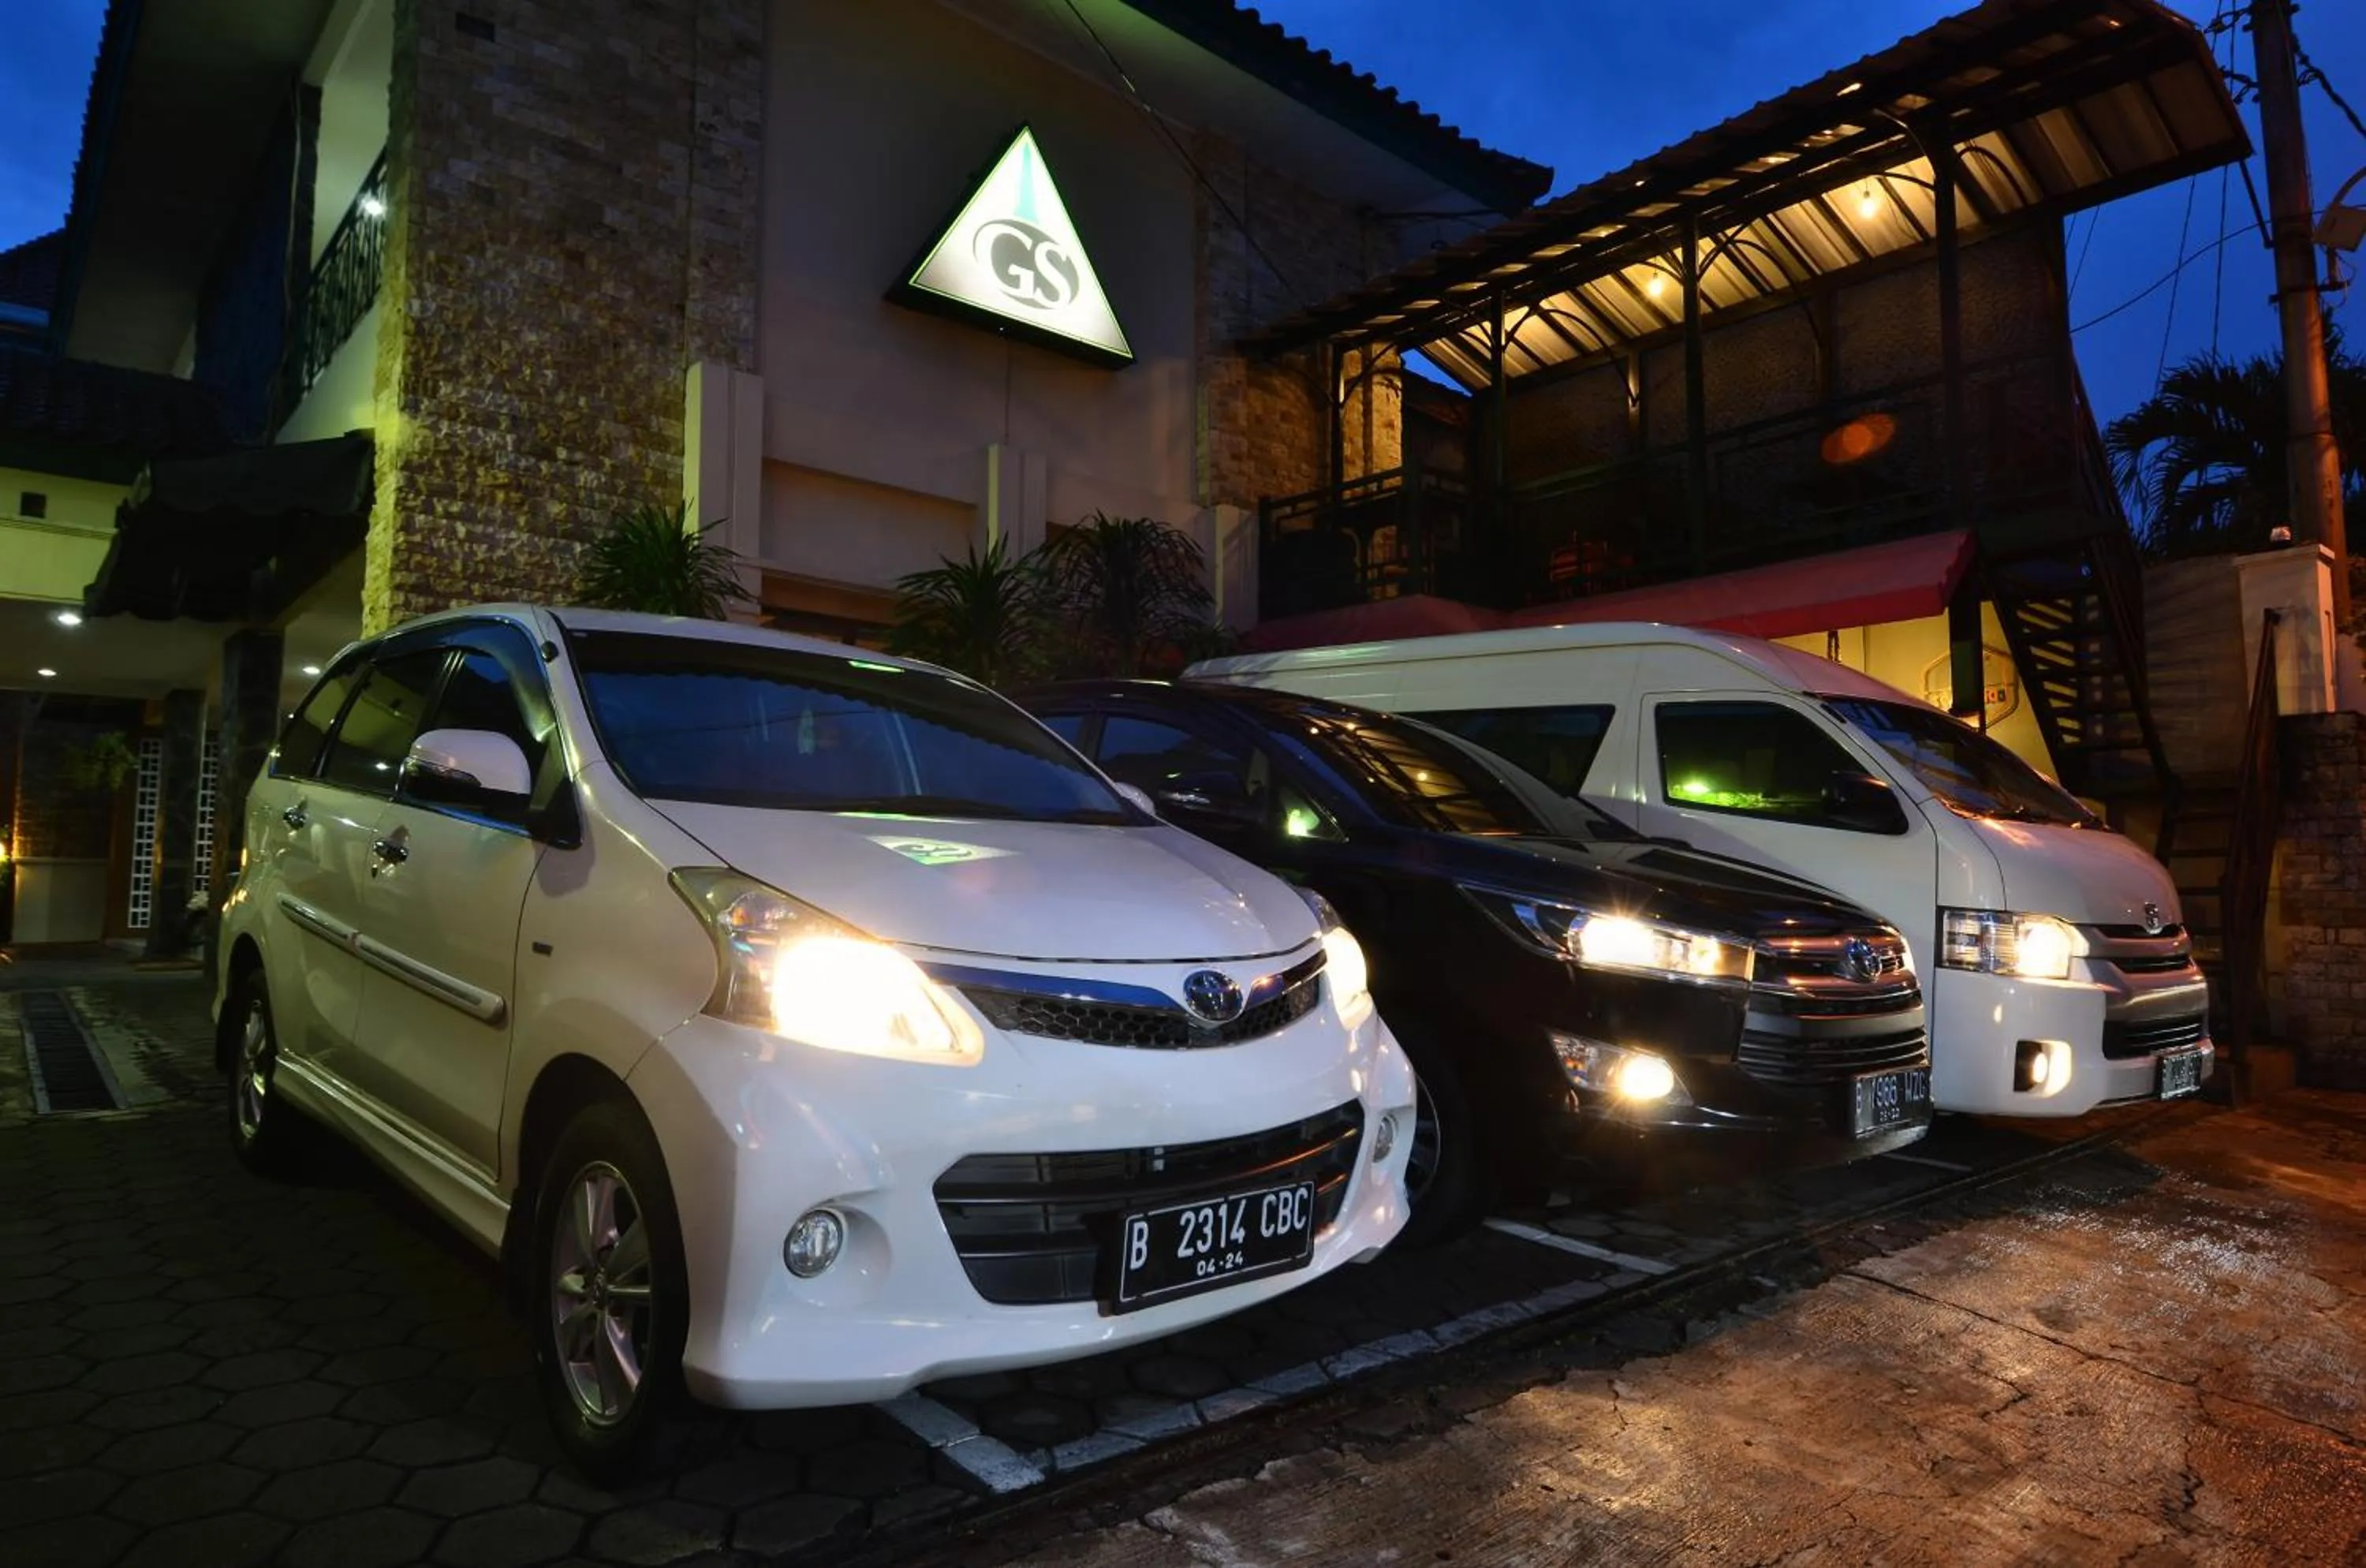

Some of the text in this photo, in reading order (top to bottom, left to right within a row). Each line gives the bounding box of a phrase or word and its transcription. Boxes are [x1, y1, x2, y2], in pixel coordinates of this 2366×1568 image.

[975, 224, 1073, 308] GS
[1129, 1186, 1309, 1271] B 2314 CBC
